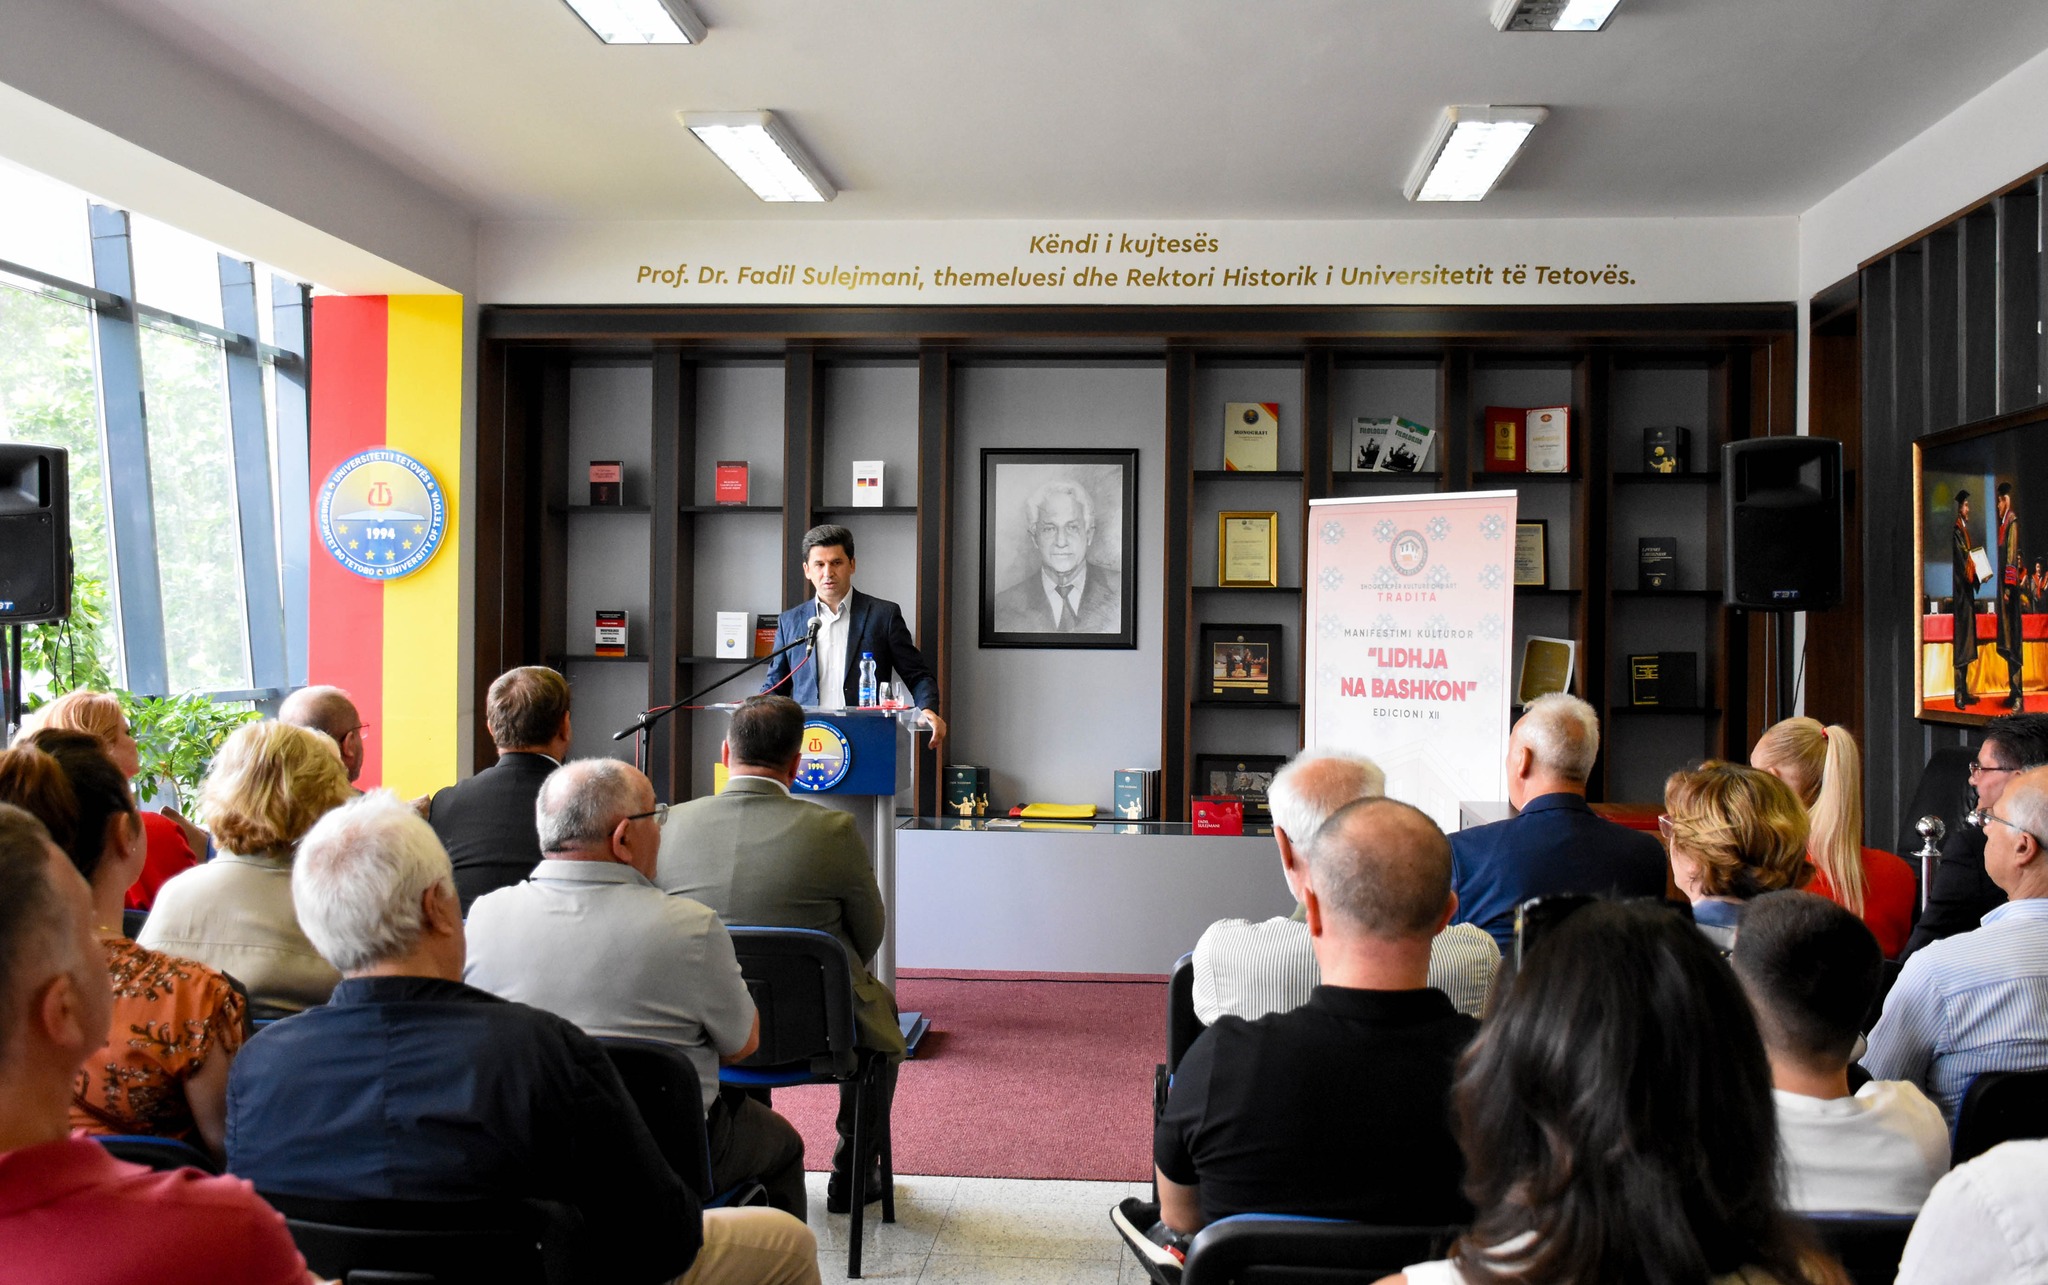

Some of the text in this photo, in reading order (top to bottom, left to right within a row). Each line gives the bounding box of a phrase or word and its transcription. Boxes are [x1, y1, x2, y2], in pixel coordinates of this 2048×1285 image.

[1030, 233, 1218, 258] Këndi i kujtesës
[637, 264, 1636, 291] Prof. Dr. Fadil Sulejmani, themeluesi dhe Rektori Historik i Universitetit të Tetovës.
[332, 452, 389, 483] UNIVERSITETI
[396, 452, 431, 483] TETOVËS
[366, 527, 396, 540] 1994
[386, 490, 442, 576] UNIVERSITY OF TETOVA
[1378, 592, 1437, 602] TRADITA
[1773, 590, 1798, 599] FBT
[1344, 629, 1473, 639] MANIFESTIMI KULTUROR
[1368, 647, 1448, 669] "LIDHJA
[1341, 676, 1477, 702] NA BASHKON"
[1373, 708, 1440, 719] EDICIONI XII
